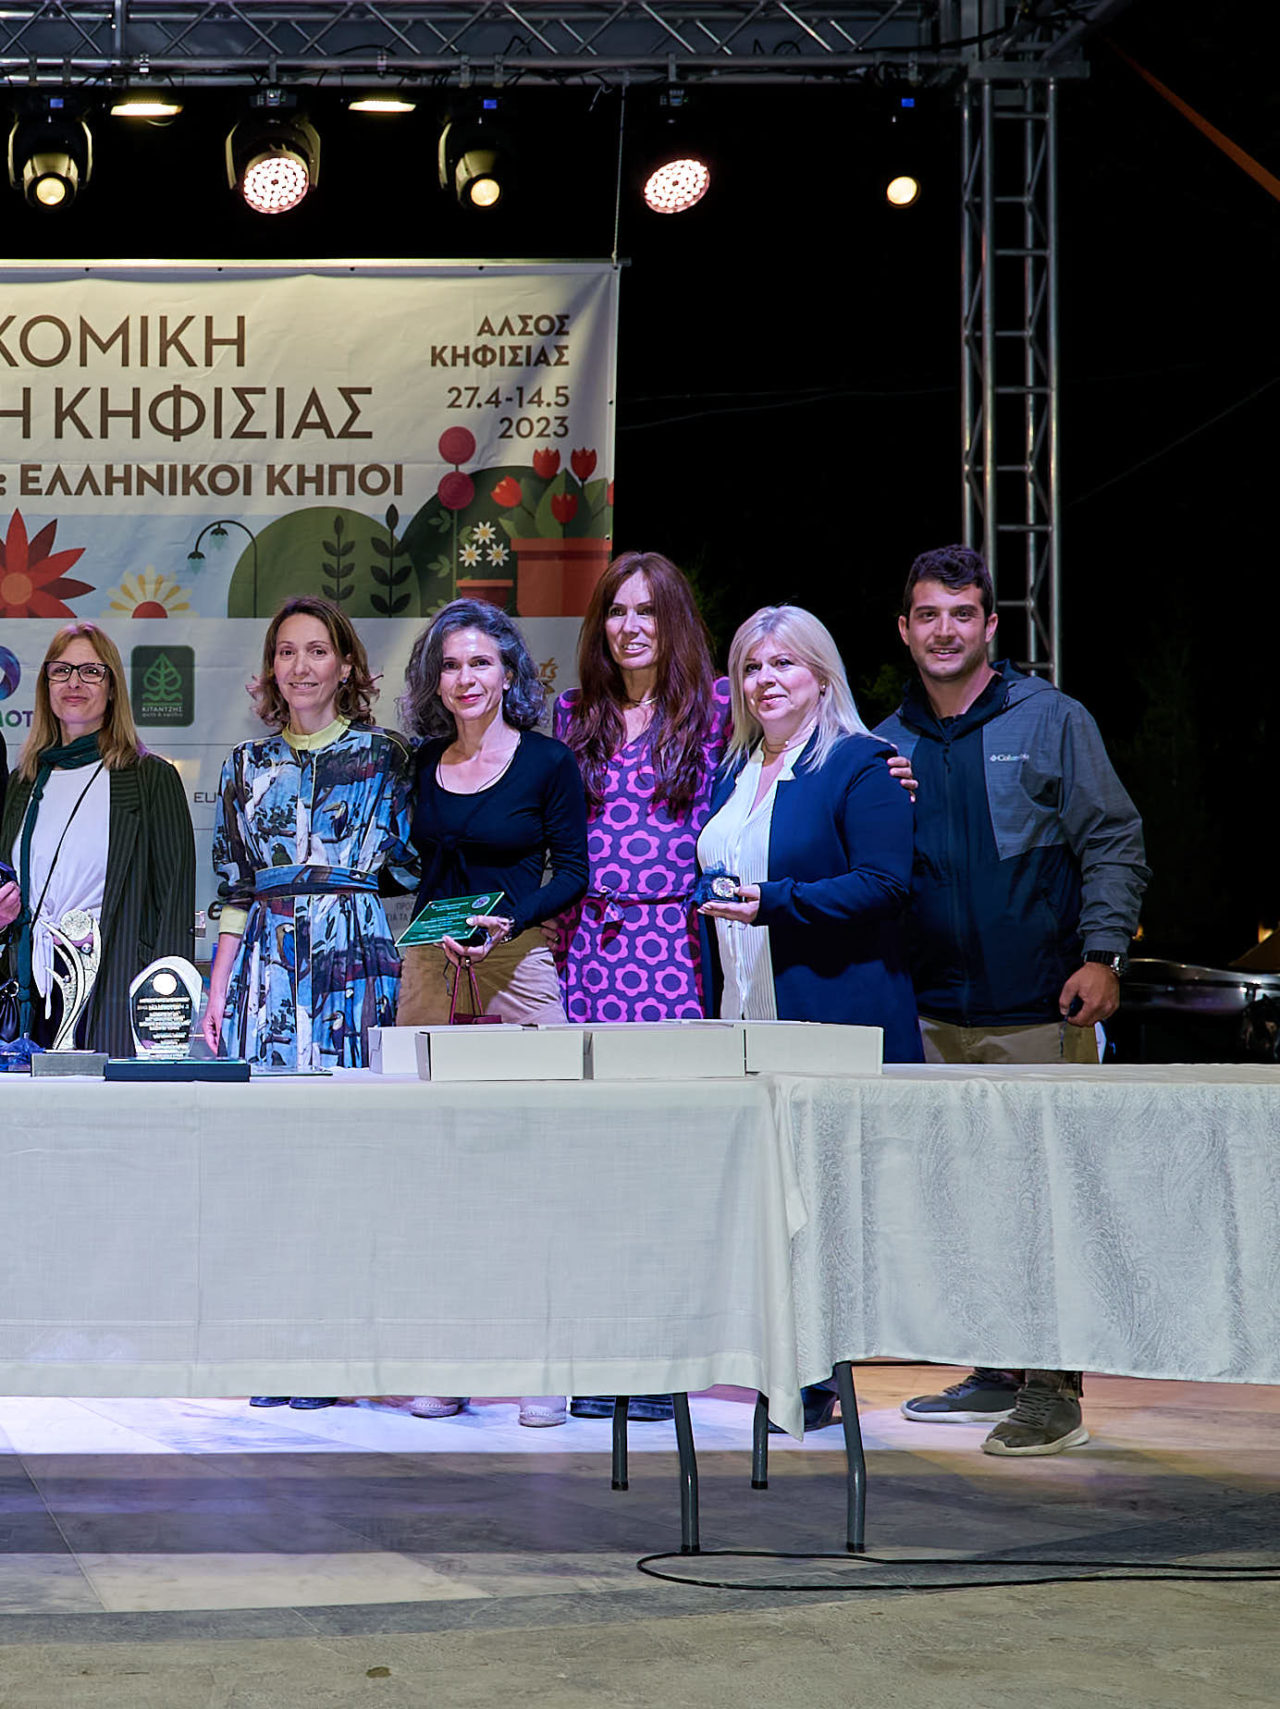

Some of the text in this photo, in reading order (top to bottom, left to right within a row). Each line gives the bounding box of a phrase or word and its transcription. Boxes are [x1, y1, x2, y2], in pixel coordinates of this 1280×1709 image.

[477, 314, 569, 336] ΑΛΣΟΣ
[431, 344, 569, 368] ΚΗΦΙΣΙΑΣ
[55, 384, 373, 442] ΚΗΦΙΣΙΑΣ
[498, 416, 569, 439] 2023
[20, 464, 253, 496] ΕΛΛΗΝΙΚΟΙ
[267, 464, 403, 496] ΚΗΠΟΙ
